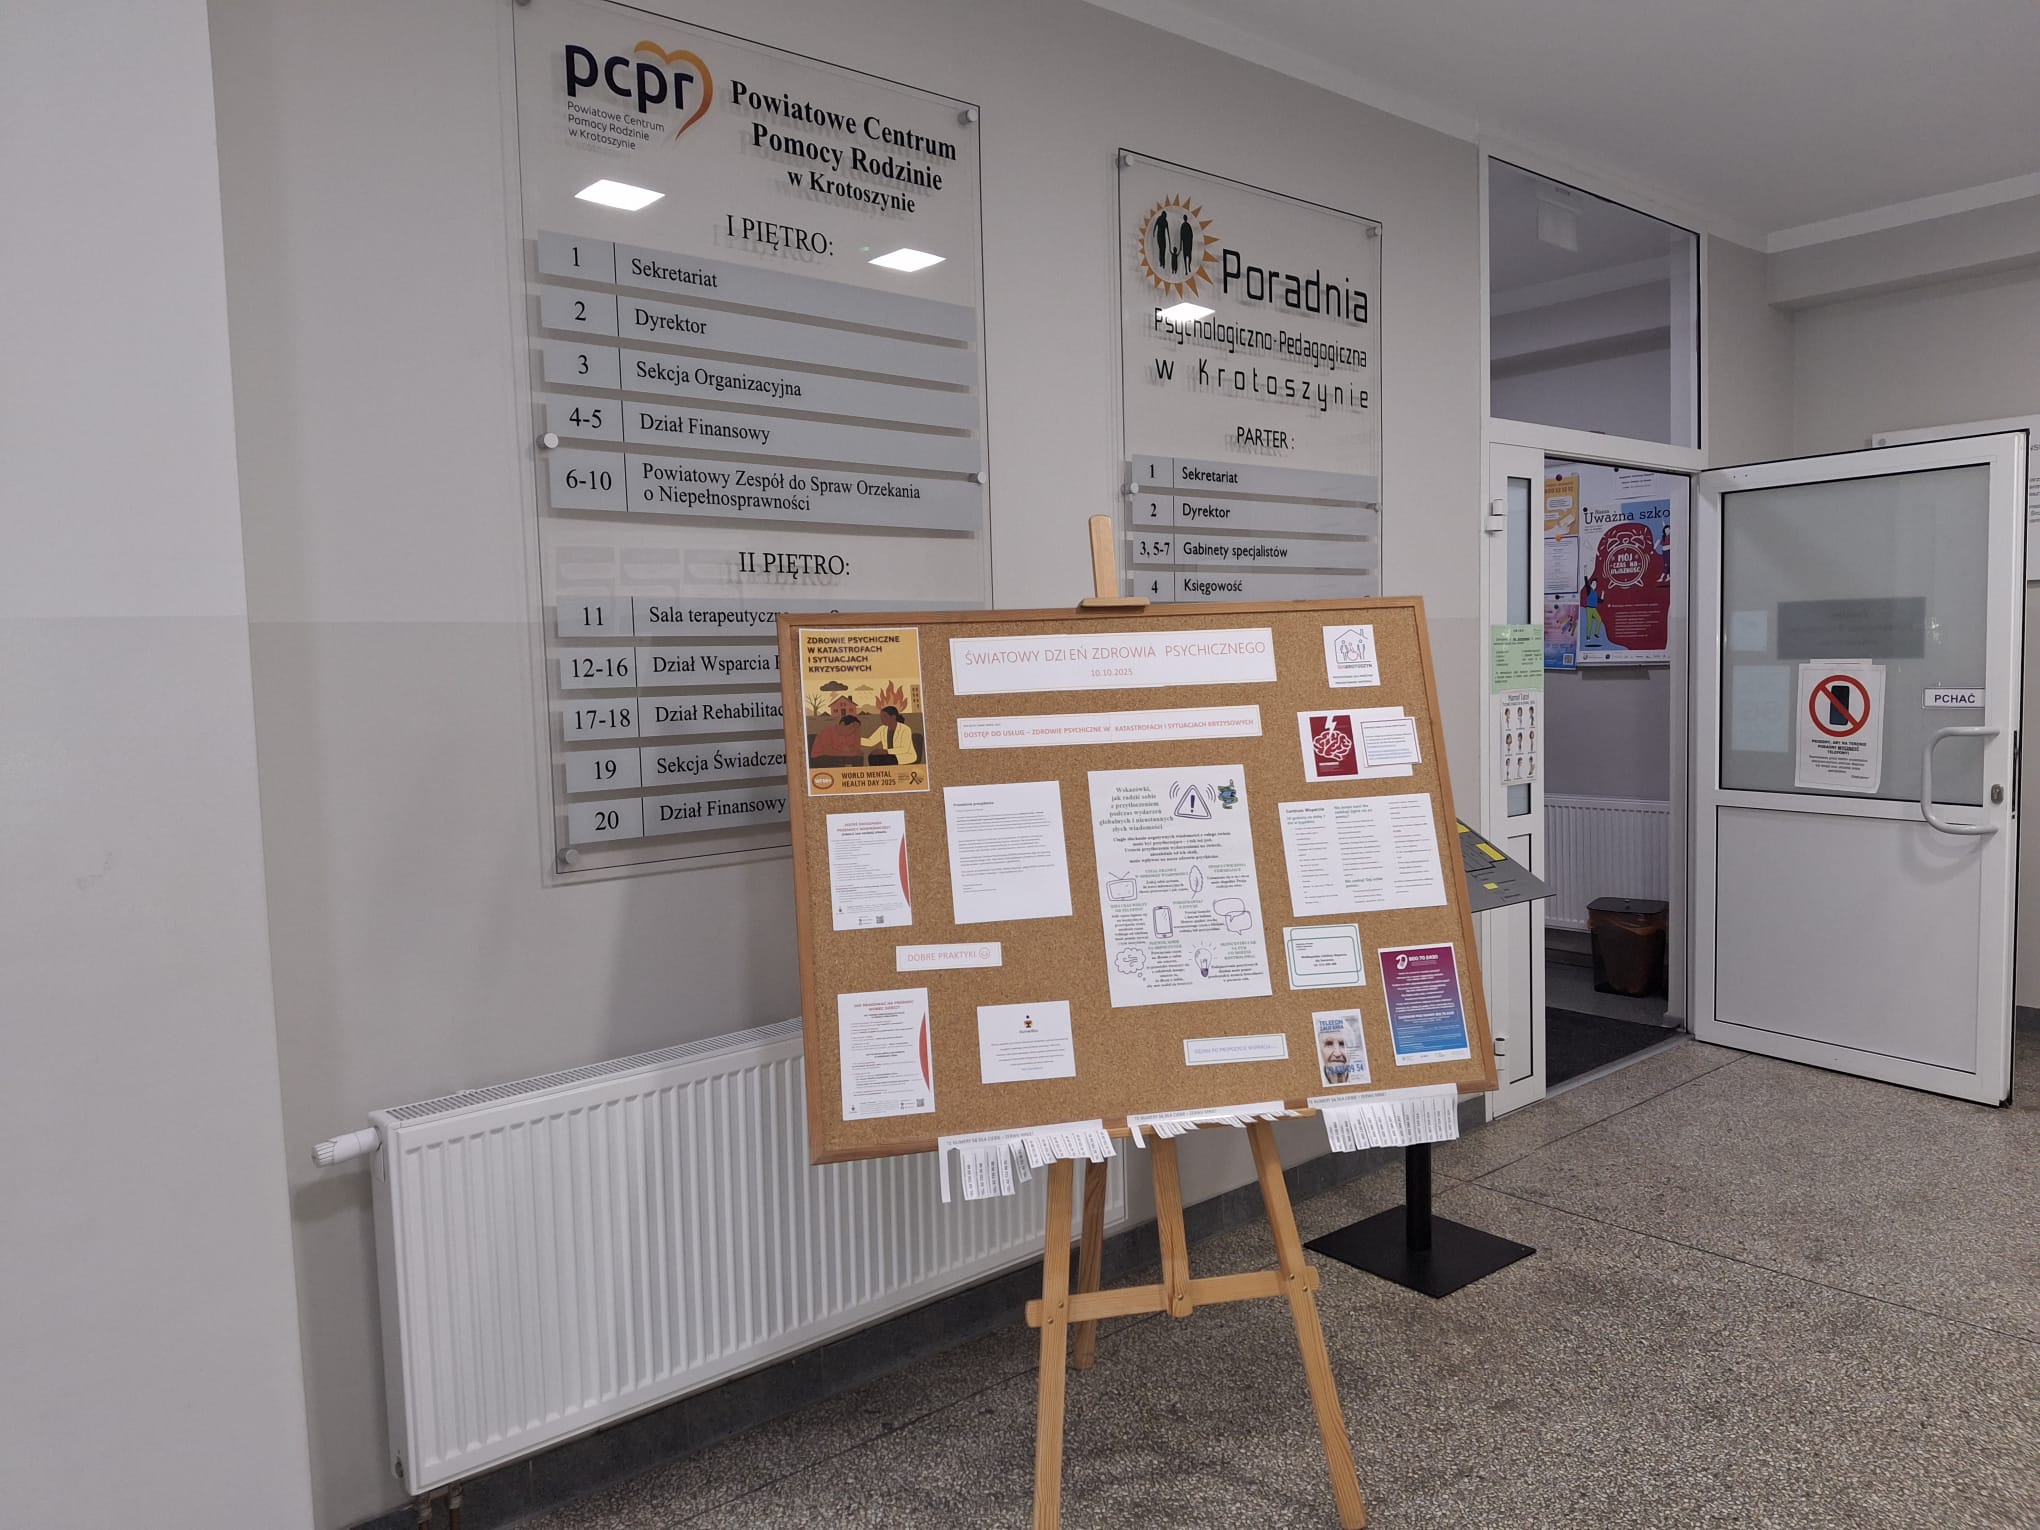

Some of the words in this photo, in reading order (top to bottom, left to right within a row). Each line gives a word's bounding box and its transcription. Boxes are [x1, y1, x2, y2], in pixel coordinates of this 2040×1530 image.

[565, 44, 694, 113] pcpr
[567, 101, 622, 121] Powiatowe
[623, 112, 665, 132] Centrum
[568, 114, 607, 135] Pomocy
[609, 121, 650, 142] Rodzinie
[731, 79, 857, 135] Powiatowe
[863, 116, 957, 161] Centrum
[569, 130, 578, 139] w
[579, 130, 636, 151] Krotoszynie
[752, 122, 844, 171] Pomocy
[850, 146, 943, 191] Rodzinie
[787, 169, 804, 187] w
[809, 171, 916, 214] Krotoszynie
[726, 213, 737, 237] I
[742, 217, 834, 258] PIĘTRO:
[572, 247, 580, 267] 1
[631, 258, 718, 289] Sekretariat
[1222, 248, 1368, 323] Poradnia
[574, 301, 587, 322] 2
[635, 308, 707, 335] Dyrektor
[577, 354, 589, 375] 3
[636, 360, 690, 385] Sekcja
[694, 368, 802, 398] Organizacyjna
[1199, 358, 1369, 411] Krotoszynie
[569, 407, 602, 429] 4-5
[640, 412, 684, 433] Dział
[688, 419, 770, 445] Finansowy
[565, 468, 612, 491] 6-10
[642, 462, 730, 488] Powiatowy
[735, 469, 785, 493] Zespół
[789, 474, 807, 491] do
[810, 476, 853, 499] Spraw
[856, 479, 921, 500] Orzekania
[1149, 464, 1156, 478] 1
[1182, 466, 1239, 484] Sekretariat
[643, 489, 654, 501] o
[659, 486, 811, 512] Niepełnosprawności
[1150, 503, 1157, 517] 2
[1182, 503, 1230, 521] Dyrektor
[1584, 510, 1634, 525] Uważna
[1640, 506, 1670, 520] szko
[1183, 542, 1229, 560] Gabinety
[1232, 545, 1288, 561] specjalistów
[739, 551, 755, 573] II
[763, 552, 851, 580] PIĘTRO:
[1151, 579, 1158, 593] 4
[1184, 578, 1243, 596] Księgowość
[582, 606, 605, 626] 11
[649, 606, 683, 623] Sala
[688, 607, 780, 627] terapeutycz
[807, 636, 846, 644] ZDROWIE
[848, 635, 901, 644] PSYCHICZNE
[808, 646, 815, 654] W
[817, 645, 882, 654] KATASTROFACH
[571, 657, 628, 679] 12-16
[653, 655, 695, 673] Dział
[700, 654, 770, 675] Wsparcia
[813, 655, 869, 664] SYTUACJACH
[965, 649, 1039, 666] ŚWIATOWY
[1092, 645, 1156, 660] ZDROWIA
[1165, 641, 1266, 657] PSYCHICZNEGO
[808, 664, 872, 673] KRYZYSOWYCH
[1091, 668, 1133, 677] 10.10.2025
[1934, 691, 1975, 705] PCHAĆ
[574, 708, 631, 730] 17-18
[655, 704, 698, 723] Dział
[703, 702, 784, 720] Rehabilitac
[593, 760, 617, 780] 19
[657, 754, 708, 775] Sekcja
[841, 772, 864, 780] WORLD
[866, 771, 891, 779] MENTAL
[842, 780, 866, 788] HEALTH
[868, 779, 880, 787] DAY
[881, 778, 896, 786] 2025
[594, 810, 619, 831] 20
[660, 801, 702, 822] Dział
[707, 796, 787, 817] Finansowy
[907, 952, 936, 963] DOBRE
[938, 950, 976, 960] PRAKTYKI
